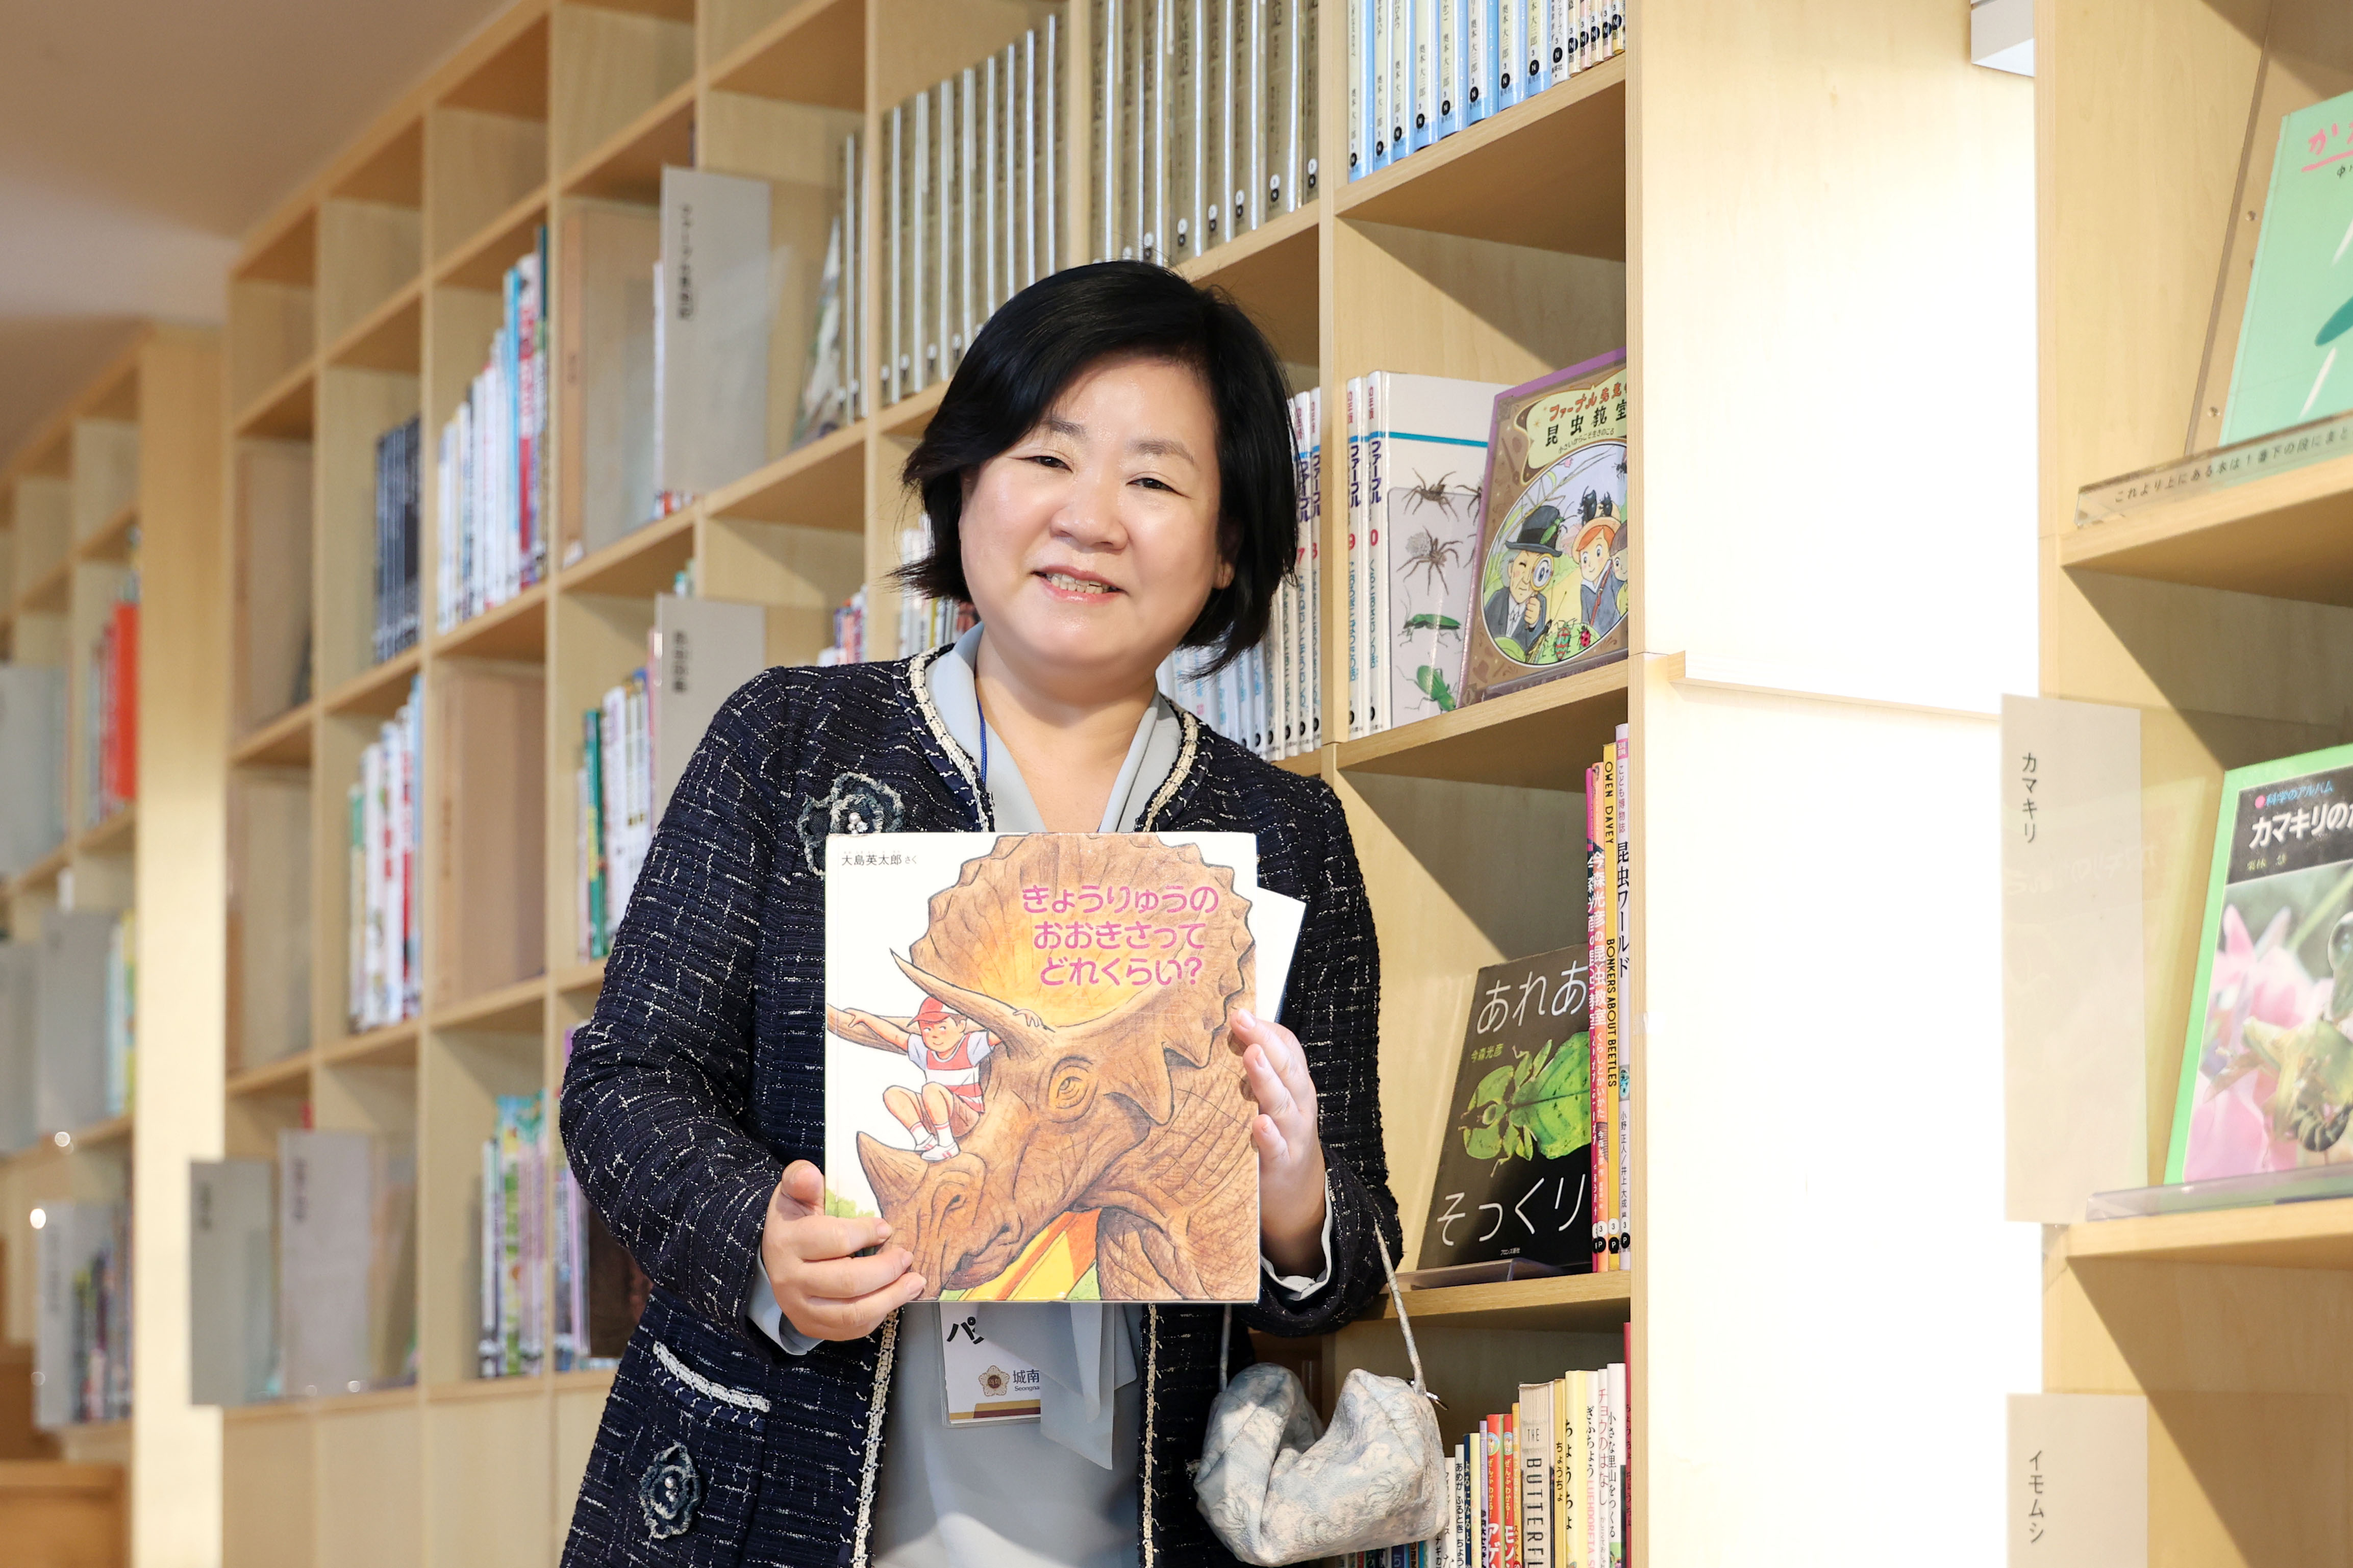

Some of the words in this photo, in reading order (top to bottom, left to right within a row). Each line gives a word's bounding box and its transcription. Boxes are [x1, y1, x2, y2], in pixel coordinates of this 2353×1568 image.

[1502, 4, 1509, 24] 奥本
[1350, 445, 1361, 508] ファーブル
[1371, 440, 1381, 504] ファーブル
[2115, 428, 2353, 503] これより上にある本は1番下の段にまと
[1605, 761, 1613, 797] OWEN
[2022, 752, 2037, 843] カマキリ
[2265, 780, 2335, 807] 科学のアルバム
[1605, 806, 1614, 844] DAVEY
[842, 854, 902, 866] 大島英太郎
[905, 855, 917, 865] さく
[1021, 884, 1219, 915] きょうりゅうの
[1617, 841, 1630, 978] 昆虫ワールド
[1033, 921, 1207, 950] おおきさって
[1593, 850, 1606, 1025] 今森光彦の昆虫教室
[1039, 956, 1204, 987] どれくらい?
[1607, 938, 1616, 994] BONKERS
[1607, 997, 1616, 1035] ABOUT
[1471, 1043, 1504, 1063] 今森光彦
[1596, 1032, 1605, 1119] くらしとかいかた
[1608, 1039, 1617, 1087] BEETLES
[1620, 1110, 1628, 1130] 小野
[1437, 1174, 1586, 1246] そっくり
[1621, 1189, 1628, 1208] 大成
[1013, 1369, 1040, 1384] 城南
[1528, 1428, 1539, 1442] THE
[1586, 1405, 1596, 1478] ぎふちょう
[1598, 1388, 1609, 1505] チョウのはなし
[1565, 1419, 1573, 1530] ちょうちょ
[1608, 1411, 1617, 1537] 小さな里山をつくる
[1587, 1480, 1595, 1554] LUEHDORFIA
[2028, 1450, 2044, 1544] イモムシ
[1505, 1525, 1514, 1568] モン
[1588, 1559, 1595, 1568] S
